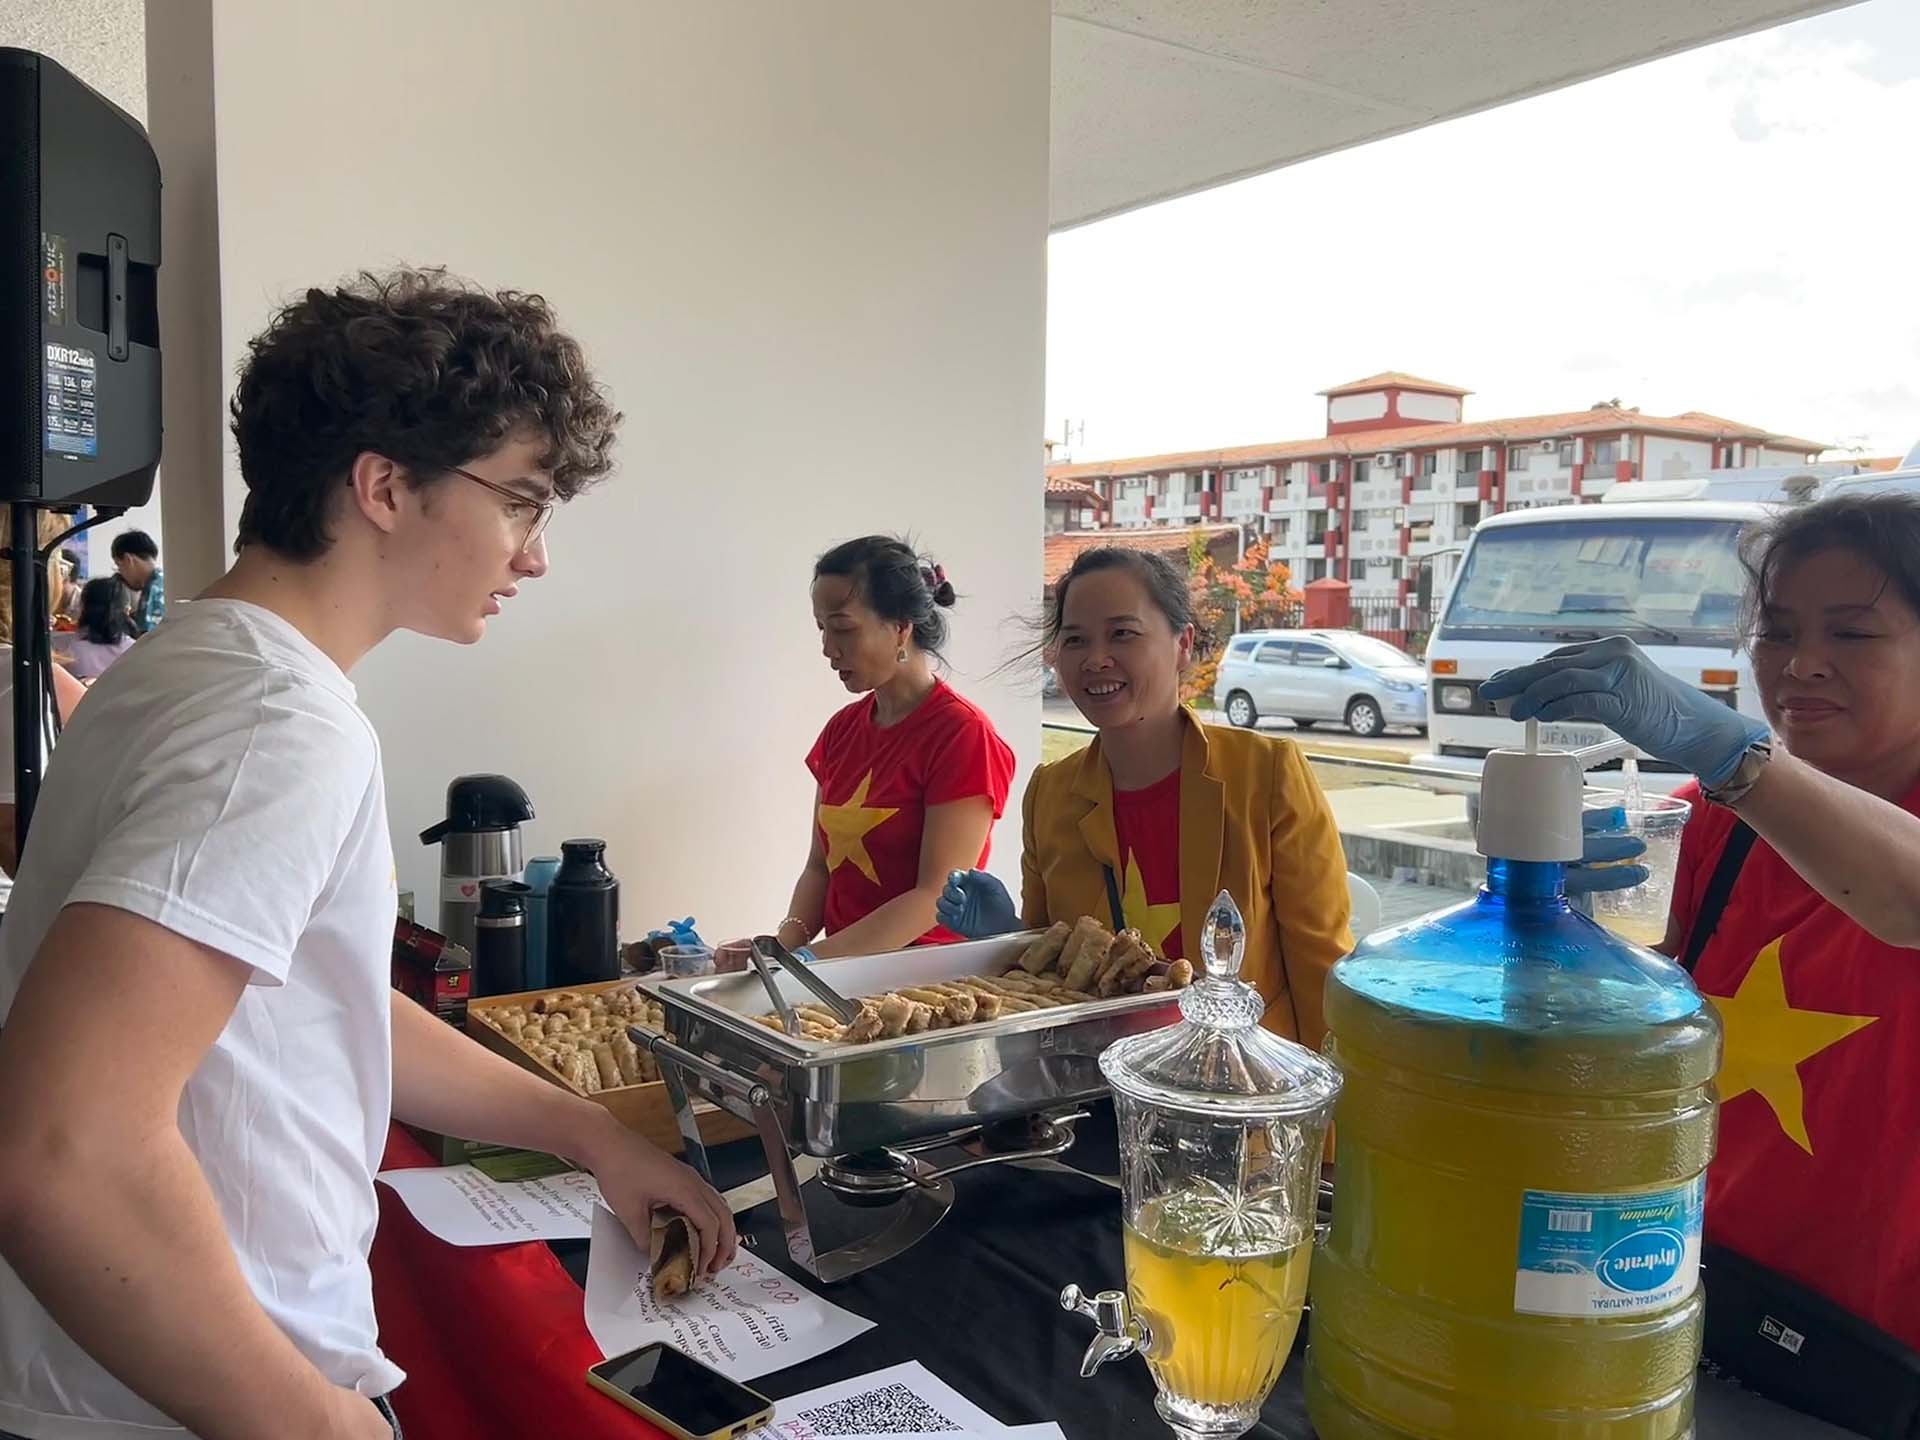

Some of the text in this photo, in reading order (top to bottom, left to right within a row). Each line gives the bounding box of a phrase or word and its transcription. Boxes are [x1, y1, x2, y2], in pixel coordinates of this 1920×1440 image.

[1619, 1203, 1680, 1222] Premium
[1614, 1248, 1676, 1273] Hydrate
[1591, 1297, 1634, 1309] NATURAL
[1635, 1291, 1667, 1306] MINERAL
[731, 1308, 776, 1350] amarão)
[764, 1314, 792, 1343] fritos
